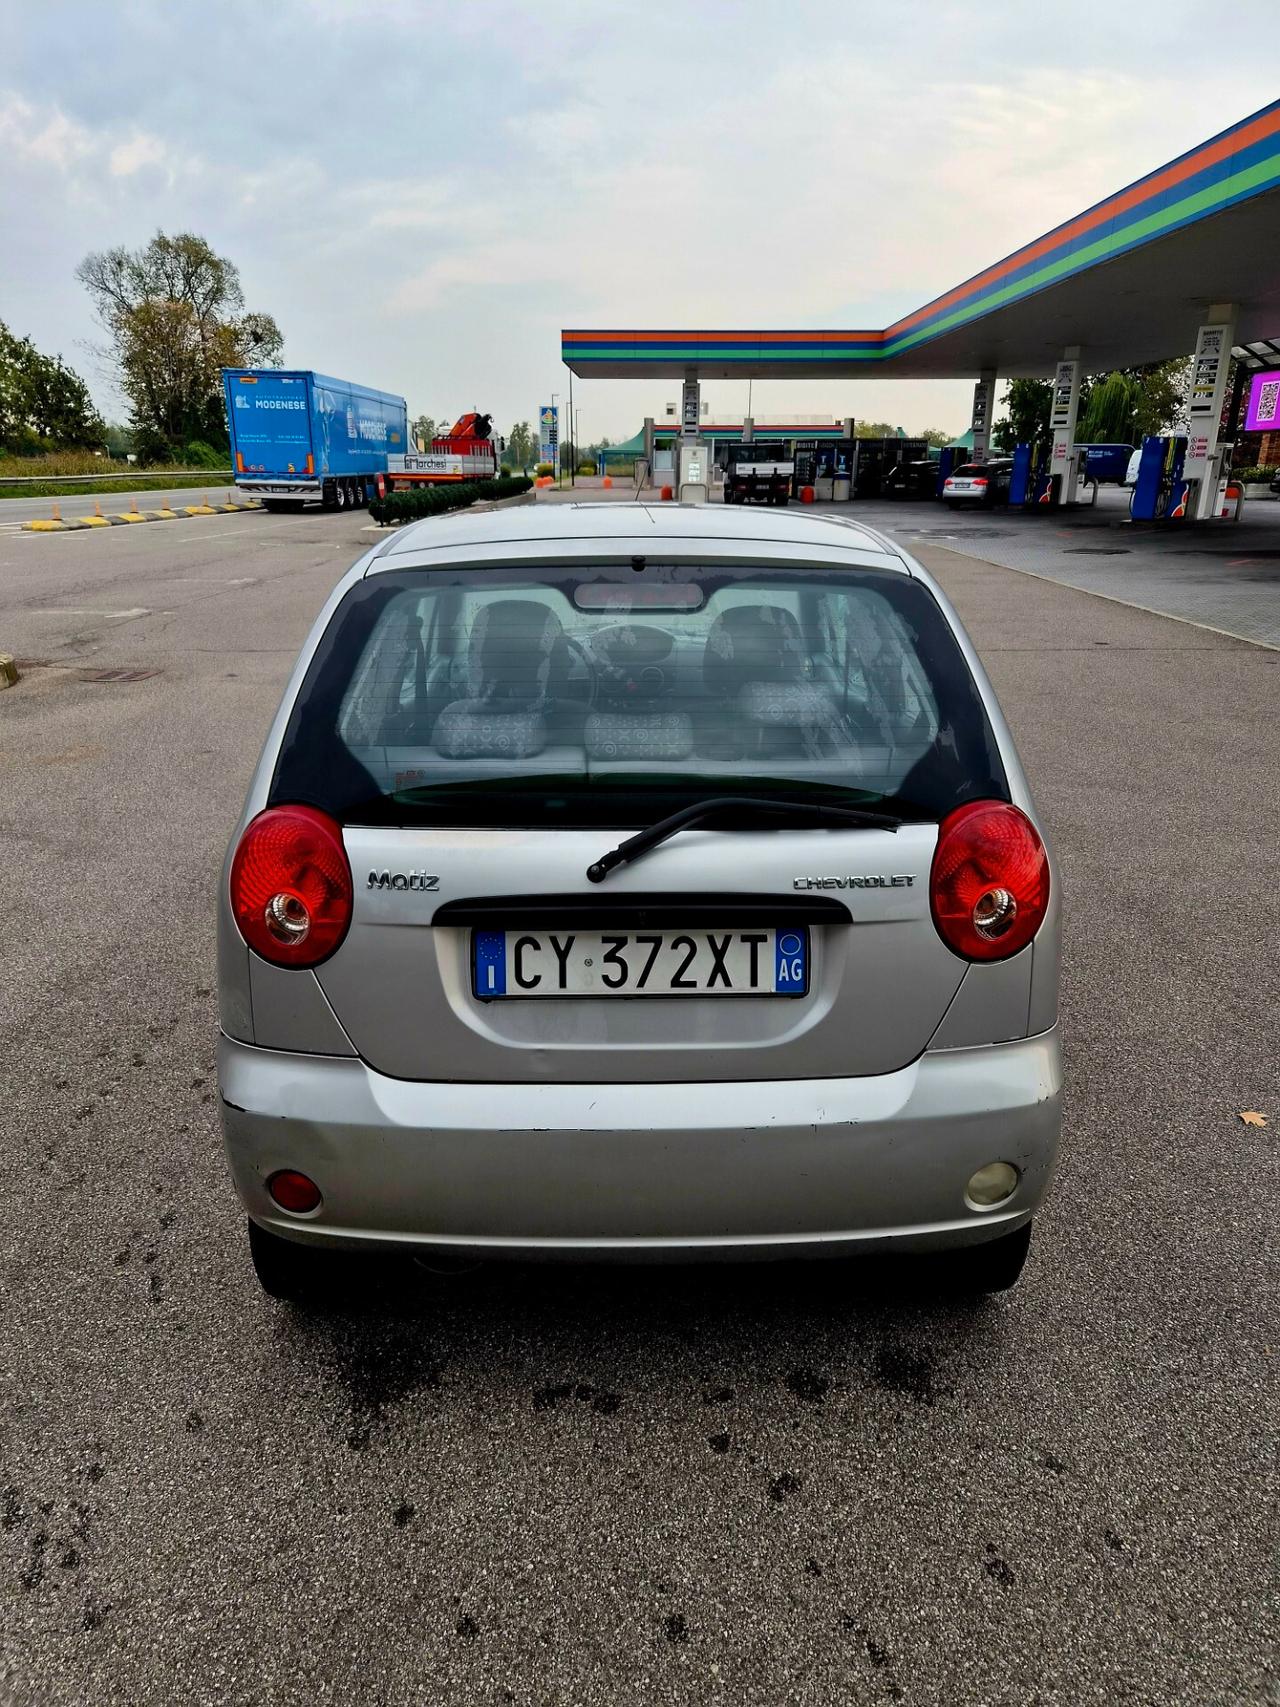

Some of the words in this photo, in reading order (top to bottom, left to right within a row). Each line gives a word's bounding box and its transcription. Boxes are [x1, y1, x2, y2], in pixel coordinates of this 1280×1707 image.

[255, 400, 306, 410] MODENESE
[410, 458, 447, 470] Marchesi
[367, 868, 440, 892] Matiz
[793, 874, 917, 890] CHEVROLET
[514, 935, 576, 989] CY
[600, 934, 768, 989] 372XT
[778, 958, 803, 982] AG
[487, 965, 495, 989] I
